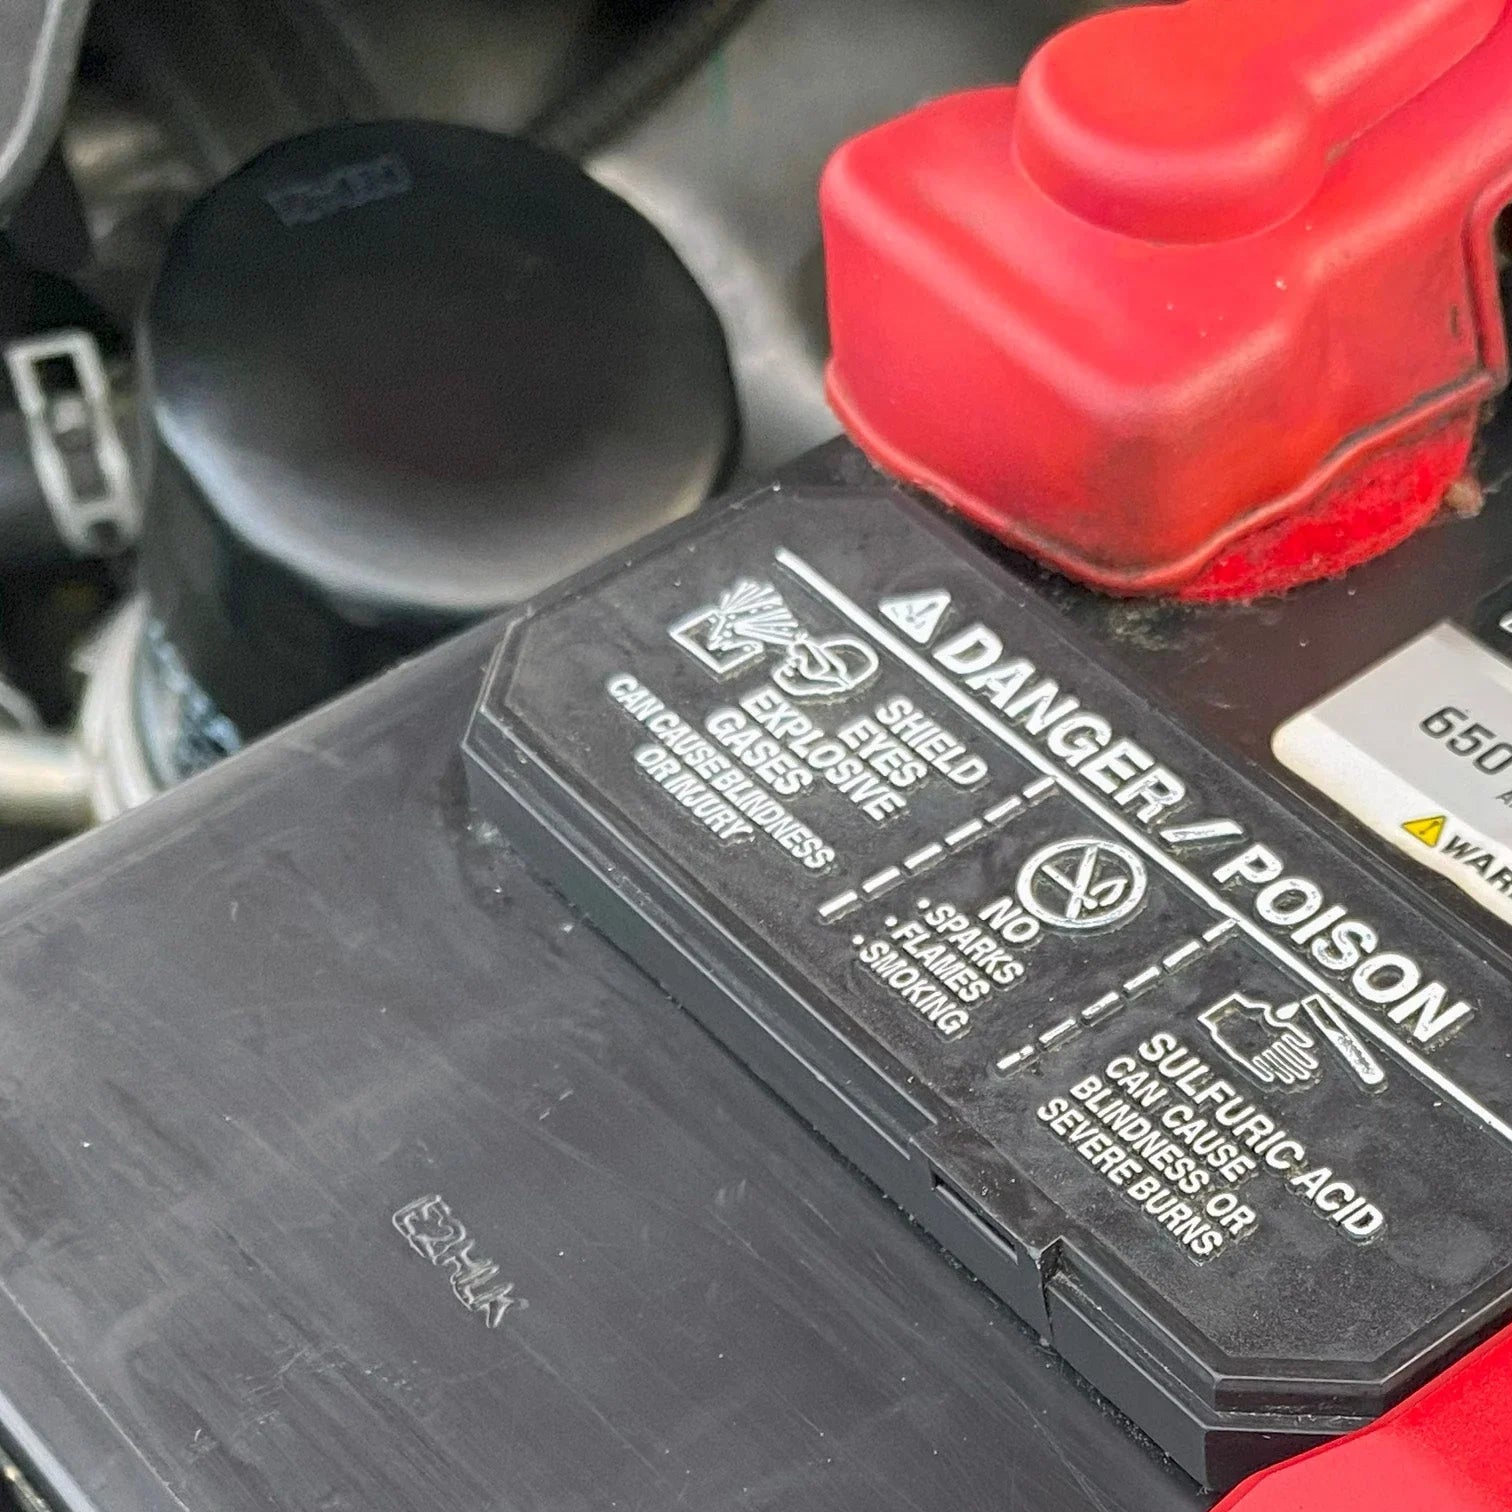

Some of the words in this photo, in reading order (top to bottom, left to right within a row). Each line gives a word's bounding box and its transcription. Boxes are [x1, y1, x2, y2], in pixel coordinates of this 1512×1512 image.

[608, 673, 665, 721] CAN
[649, 709, 731, 780] CAUSE
[710, 769, 836, 869] BLINDNESS
[634, 743, 682, 783] OR
[661, 773, 753, 840] INJURY
[704, 706, 813, 795] GASES
[739, 686, 907, 821] EXPLOSIVE
[837, 716, 928, 787] EYES
[875, 696, 988, 786] SHIELD
[978, 897, 1040, 943] NO
[1036, 1098, 1143, 1186] SEVERE
[1127, 1177, 1224, 1257] BURNS
[1070, 1074, 1209, 1194] BLINDNESS
[1205, 1192, 1257, 1235] OR
[1105, 1055, 1168, 1108] CAN
[1163, 1104, 1258, 1183] CAUSE
[1138, 1032, 1303, 1171] SULFURIC
[1291, 1166, 1386, 1237] ACID
